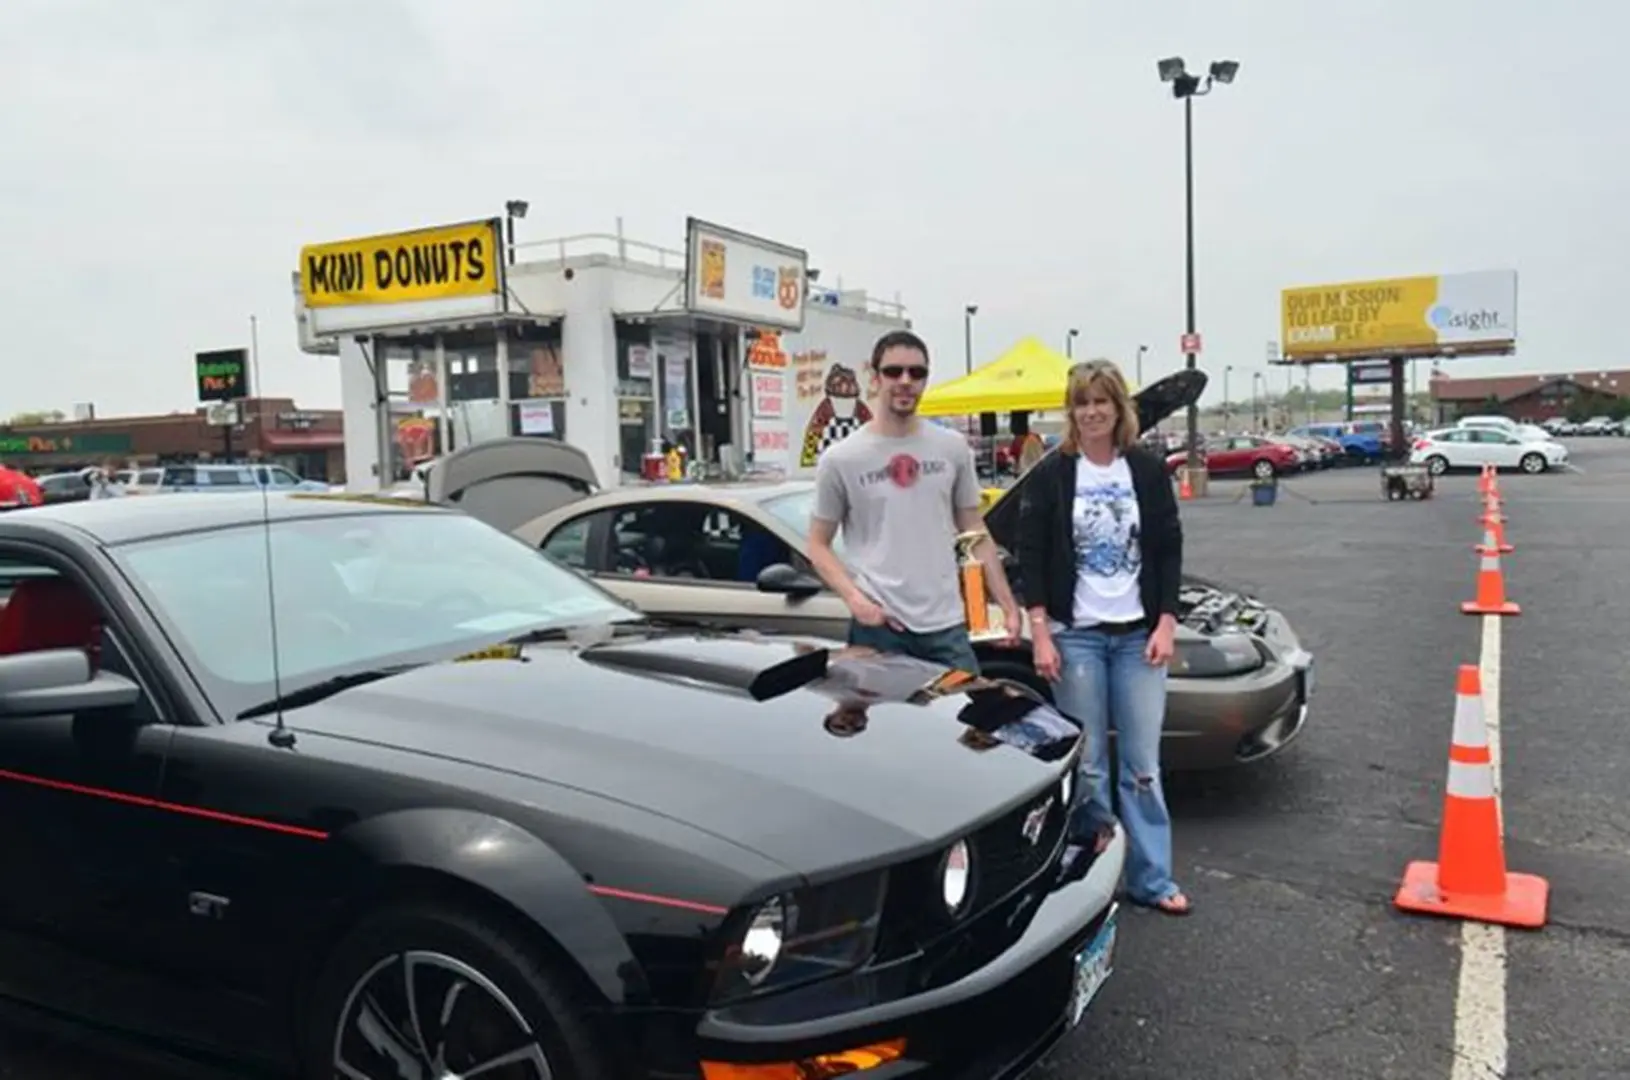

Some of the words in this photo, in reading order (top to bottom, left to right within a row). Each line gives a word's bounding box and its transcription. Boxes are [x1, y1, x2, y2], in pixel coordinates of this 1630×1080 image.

[308, 252, 363, 294] MINI
[374, 238, 486, 290] DONUTS
[1287, 293, 1321, 310] OUR
[1287, 310, 1309, 327] TO
[1311, 305, 1354, 325] LEAD
[1357, 301, 1382, 322] BY
[188, 891, 230, 919] GT
